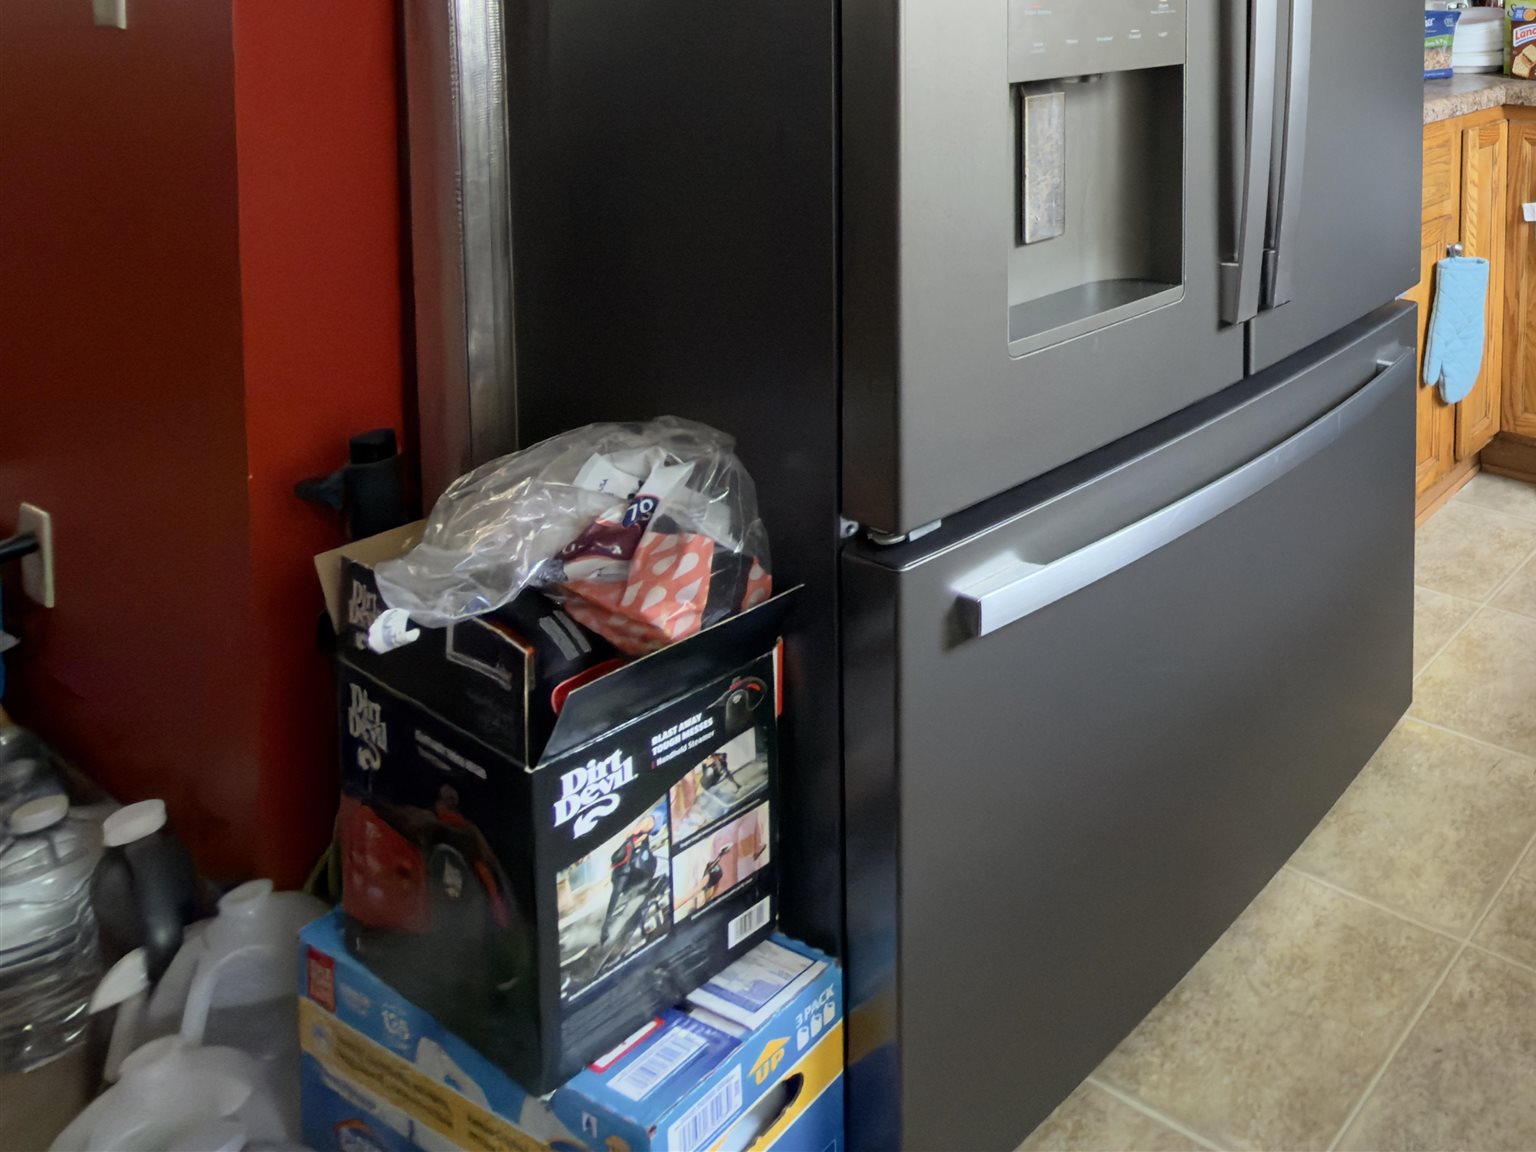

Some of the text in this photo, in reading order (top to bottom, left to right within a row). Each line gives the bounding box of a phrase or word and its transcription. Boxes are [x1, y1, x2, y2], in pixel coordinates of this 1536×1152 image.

[628, 498, 654, 523] 70
[651, 712, 703, 747] BLAST AWAY
[652, 716, 714, 757] TOUGH MESSES
[553, 755, 639, 828] Devil
[560, 748, 623, 796] Dirt
[804, 983, 835, 1020] PACK
[755, 1047, 785, 1086] UP
